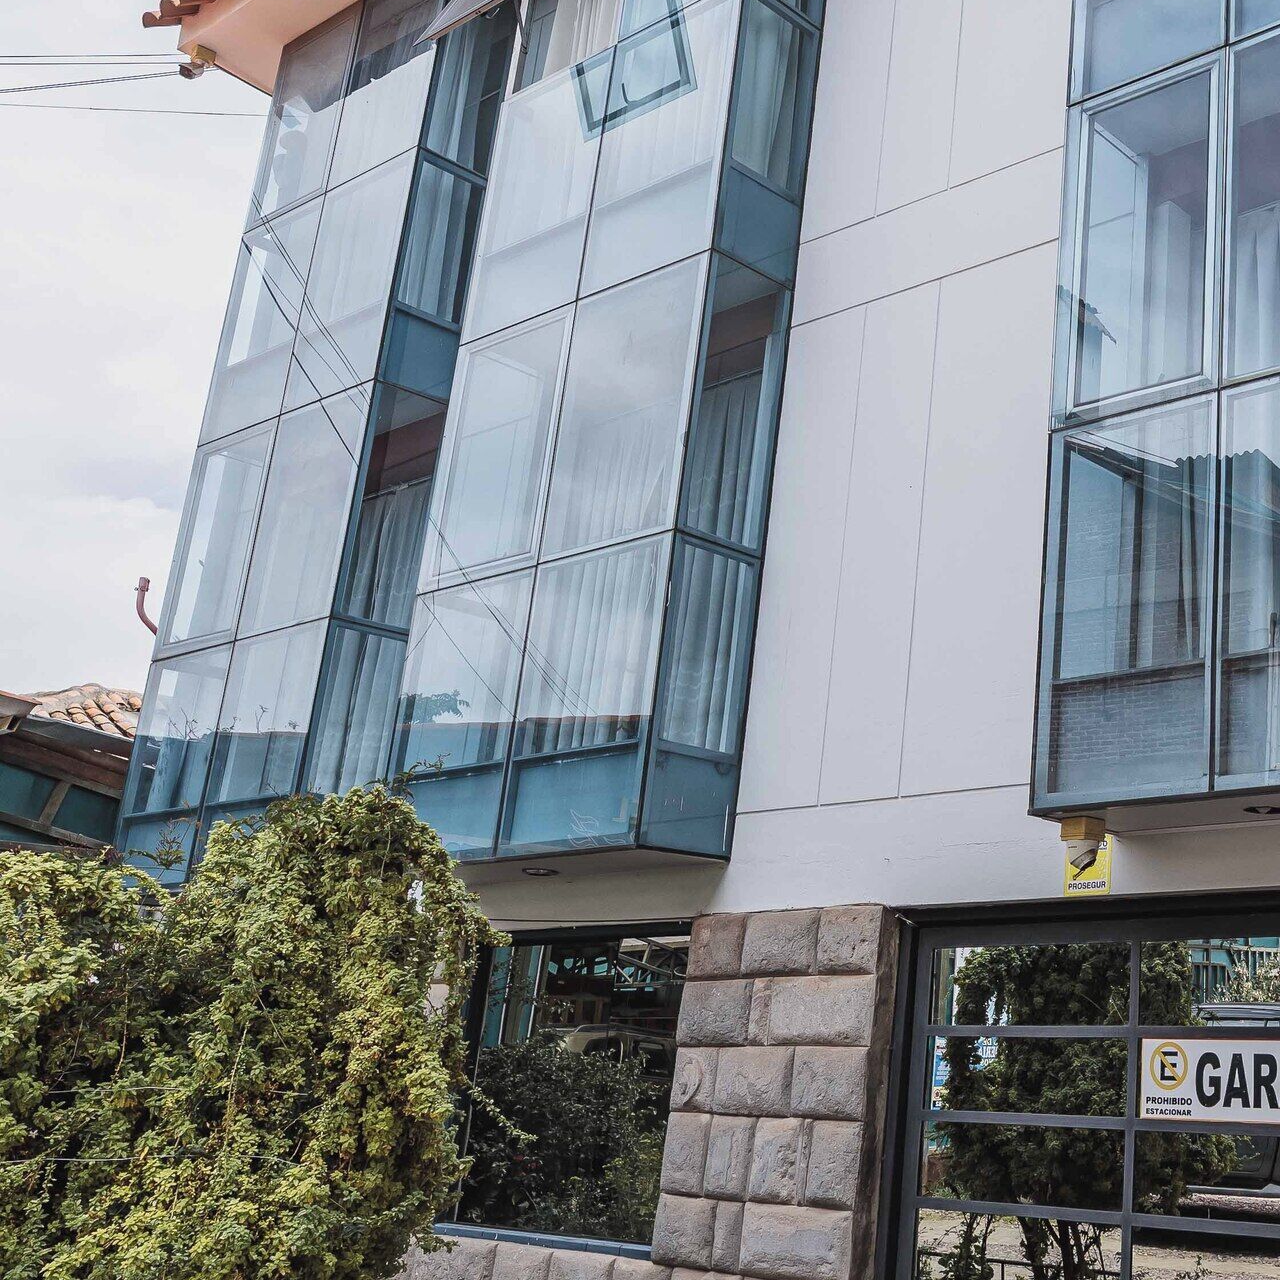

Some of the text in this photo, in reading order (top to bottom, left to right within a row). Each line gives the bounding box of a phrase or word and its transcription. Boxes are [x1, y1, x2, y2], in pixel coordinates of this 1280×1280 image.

[1068, 880, 1106, 890] PROSEGUR
[1145, 1096, 1192, 1106] PROHIBIDO
[1145, 1107, 1192, 1117] ESTACIONAR
